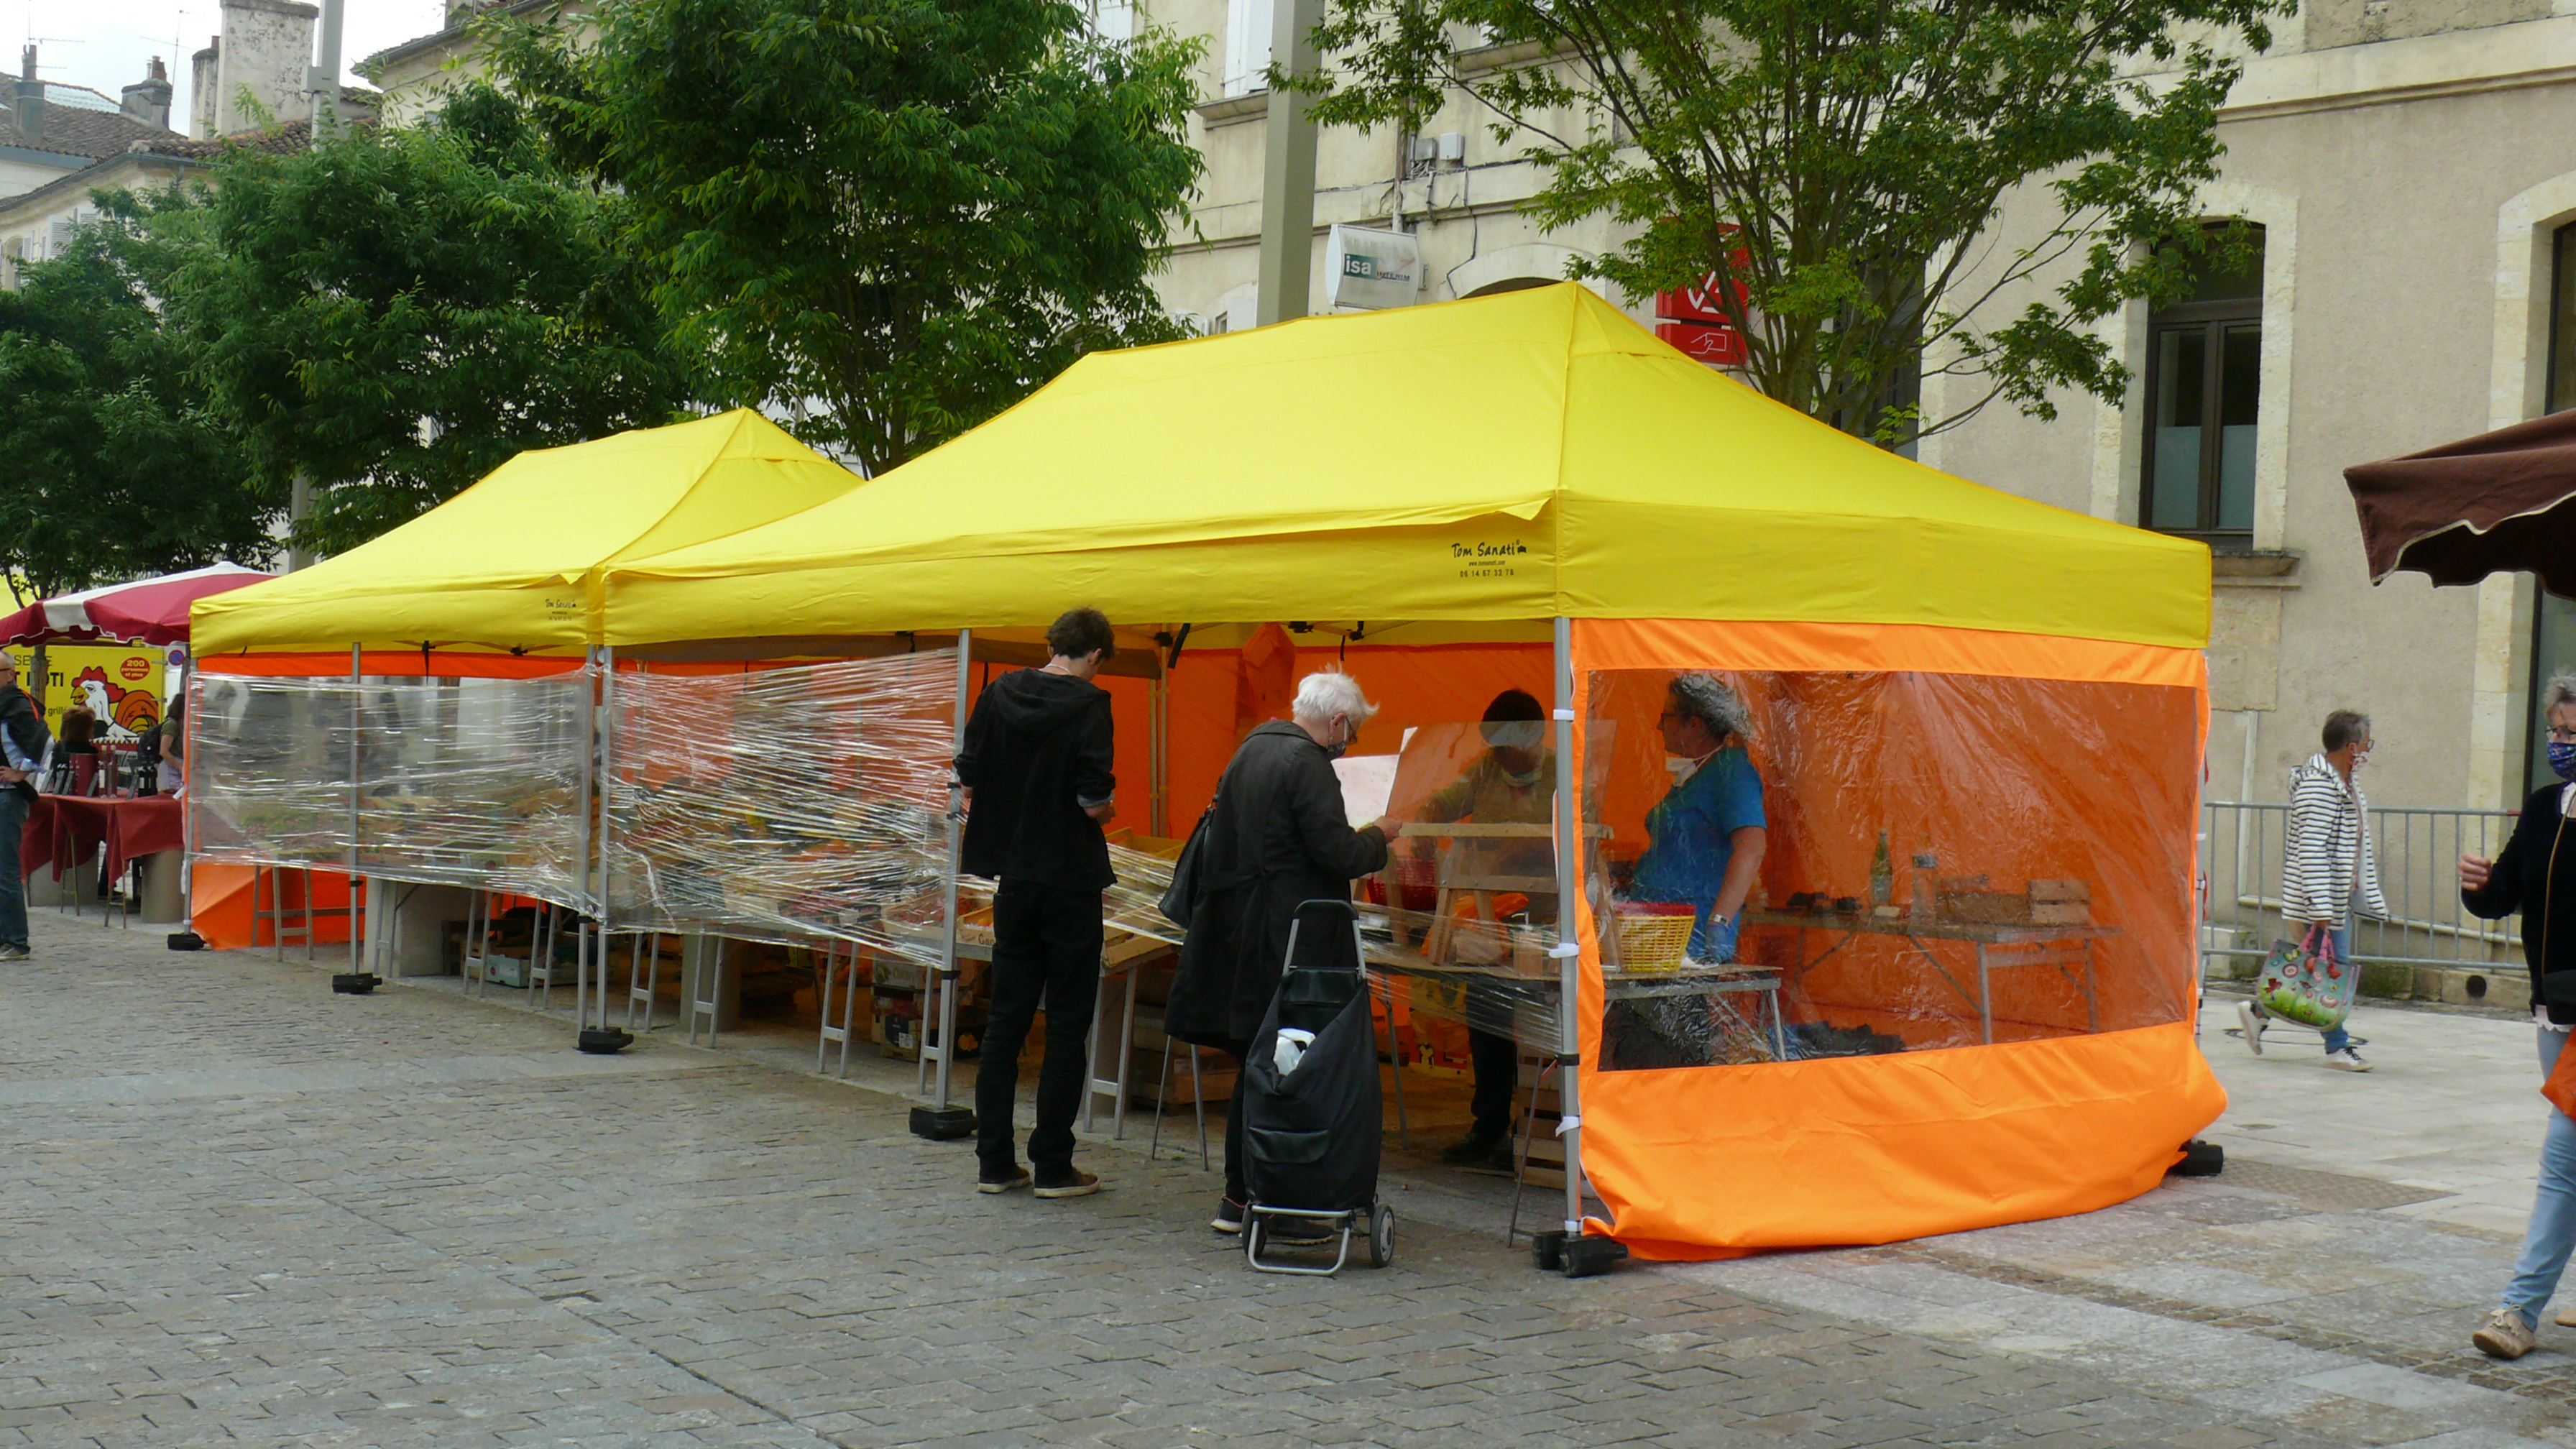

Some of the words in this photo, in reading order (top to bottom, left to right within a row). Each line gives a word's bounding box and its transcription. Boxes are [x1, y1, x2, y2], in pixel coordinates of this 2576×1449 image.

[1345, 255, 1371, 275] isa
[1376, 271, 1410, 281] INTERIM
[1451, 543, 1473, 558] Tom
[1477, 541, 1515, 557] Sanati
